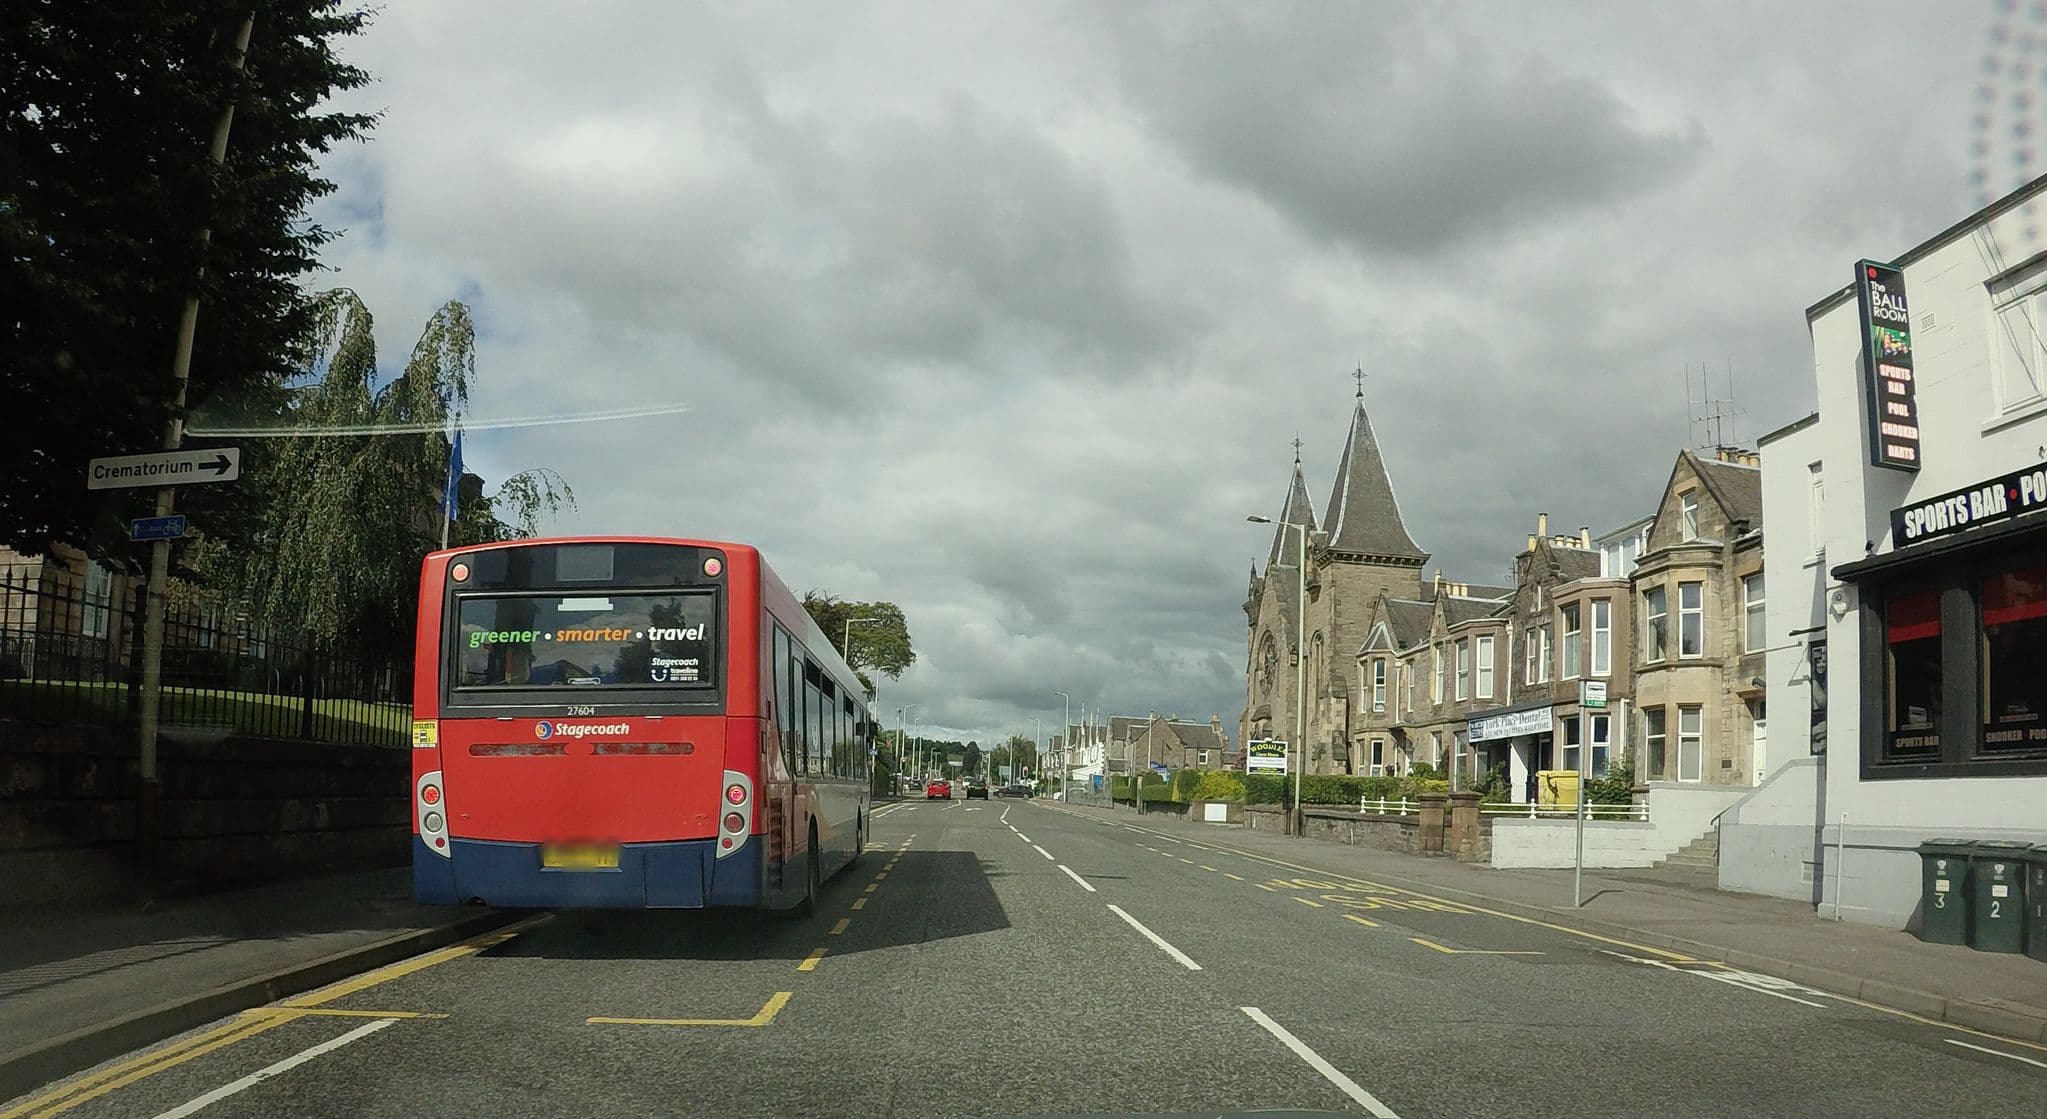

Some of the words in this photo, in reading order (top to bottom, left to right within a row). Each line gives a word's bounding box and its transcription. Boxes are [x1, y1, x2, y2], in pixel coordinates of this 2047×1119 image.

[1870, 280, 1886, 292] The
[1872, 290, 1907, 312] BALL
[1873, 306, 1907, 324] ROOM
[1879, 363, 1911, 382] SPORTS
[1887, 380, 1905, 395] BAR
[1887, 401, 1909, 417] POOL
[1887, 444, 1915, 461] DARTS
[94, 459, 193, 480] Crematorium
[1904, 494, 1969, 539] SPORTS
[1970, 483, 2008, 521] BAR
[2020, 468, 2047, 506] PO
[469, 627, 541, 649] greener
[556, 626, 633, 643] smarter
[648, 623, 704, 641] travel
[651, 657, 699, 668] Stagecoach
[567, 706, 595, 716] 27604
[555, 722, 630, 739] Stagecoach
[1985, 729, 2023, 743] SNOOKER
[1896, 737, 1924, 748] SPORTS
[1934, 893, 1945, 909] 3
[1990, 900, 2001, 918] 2
